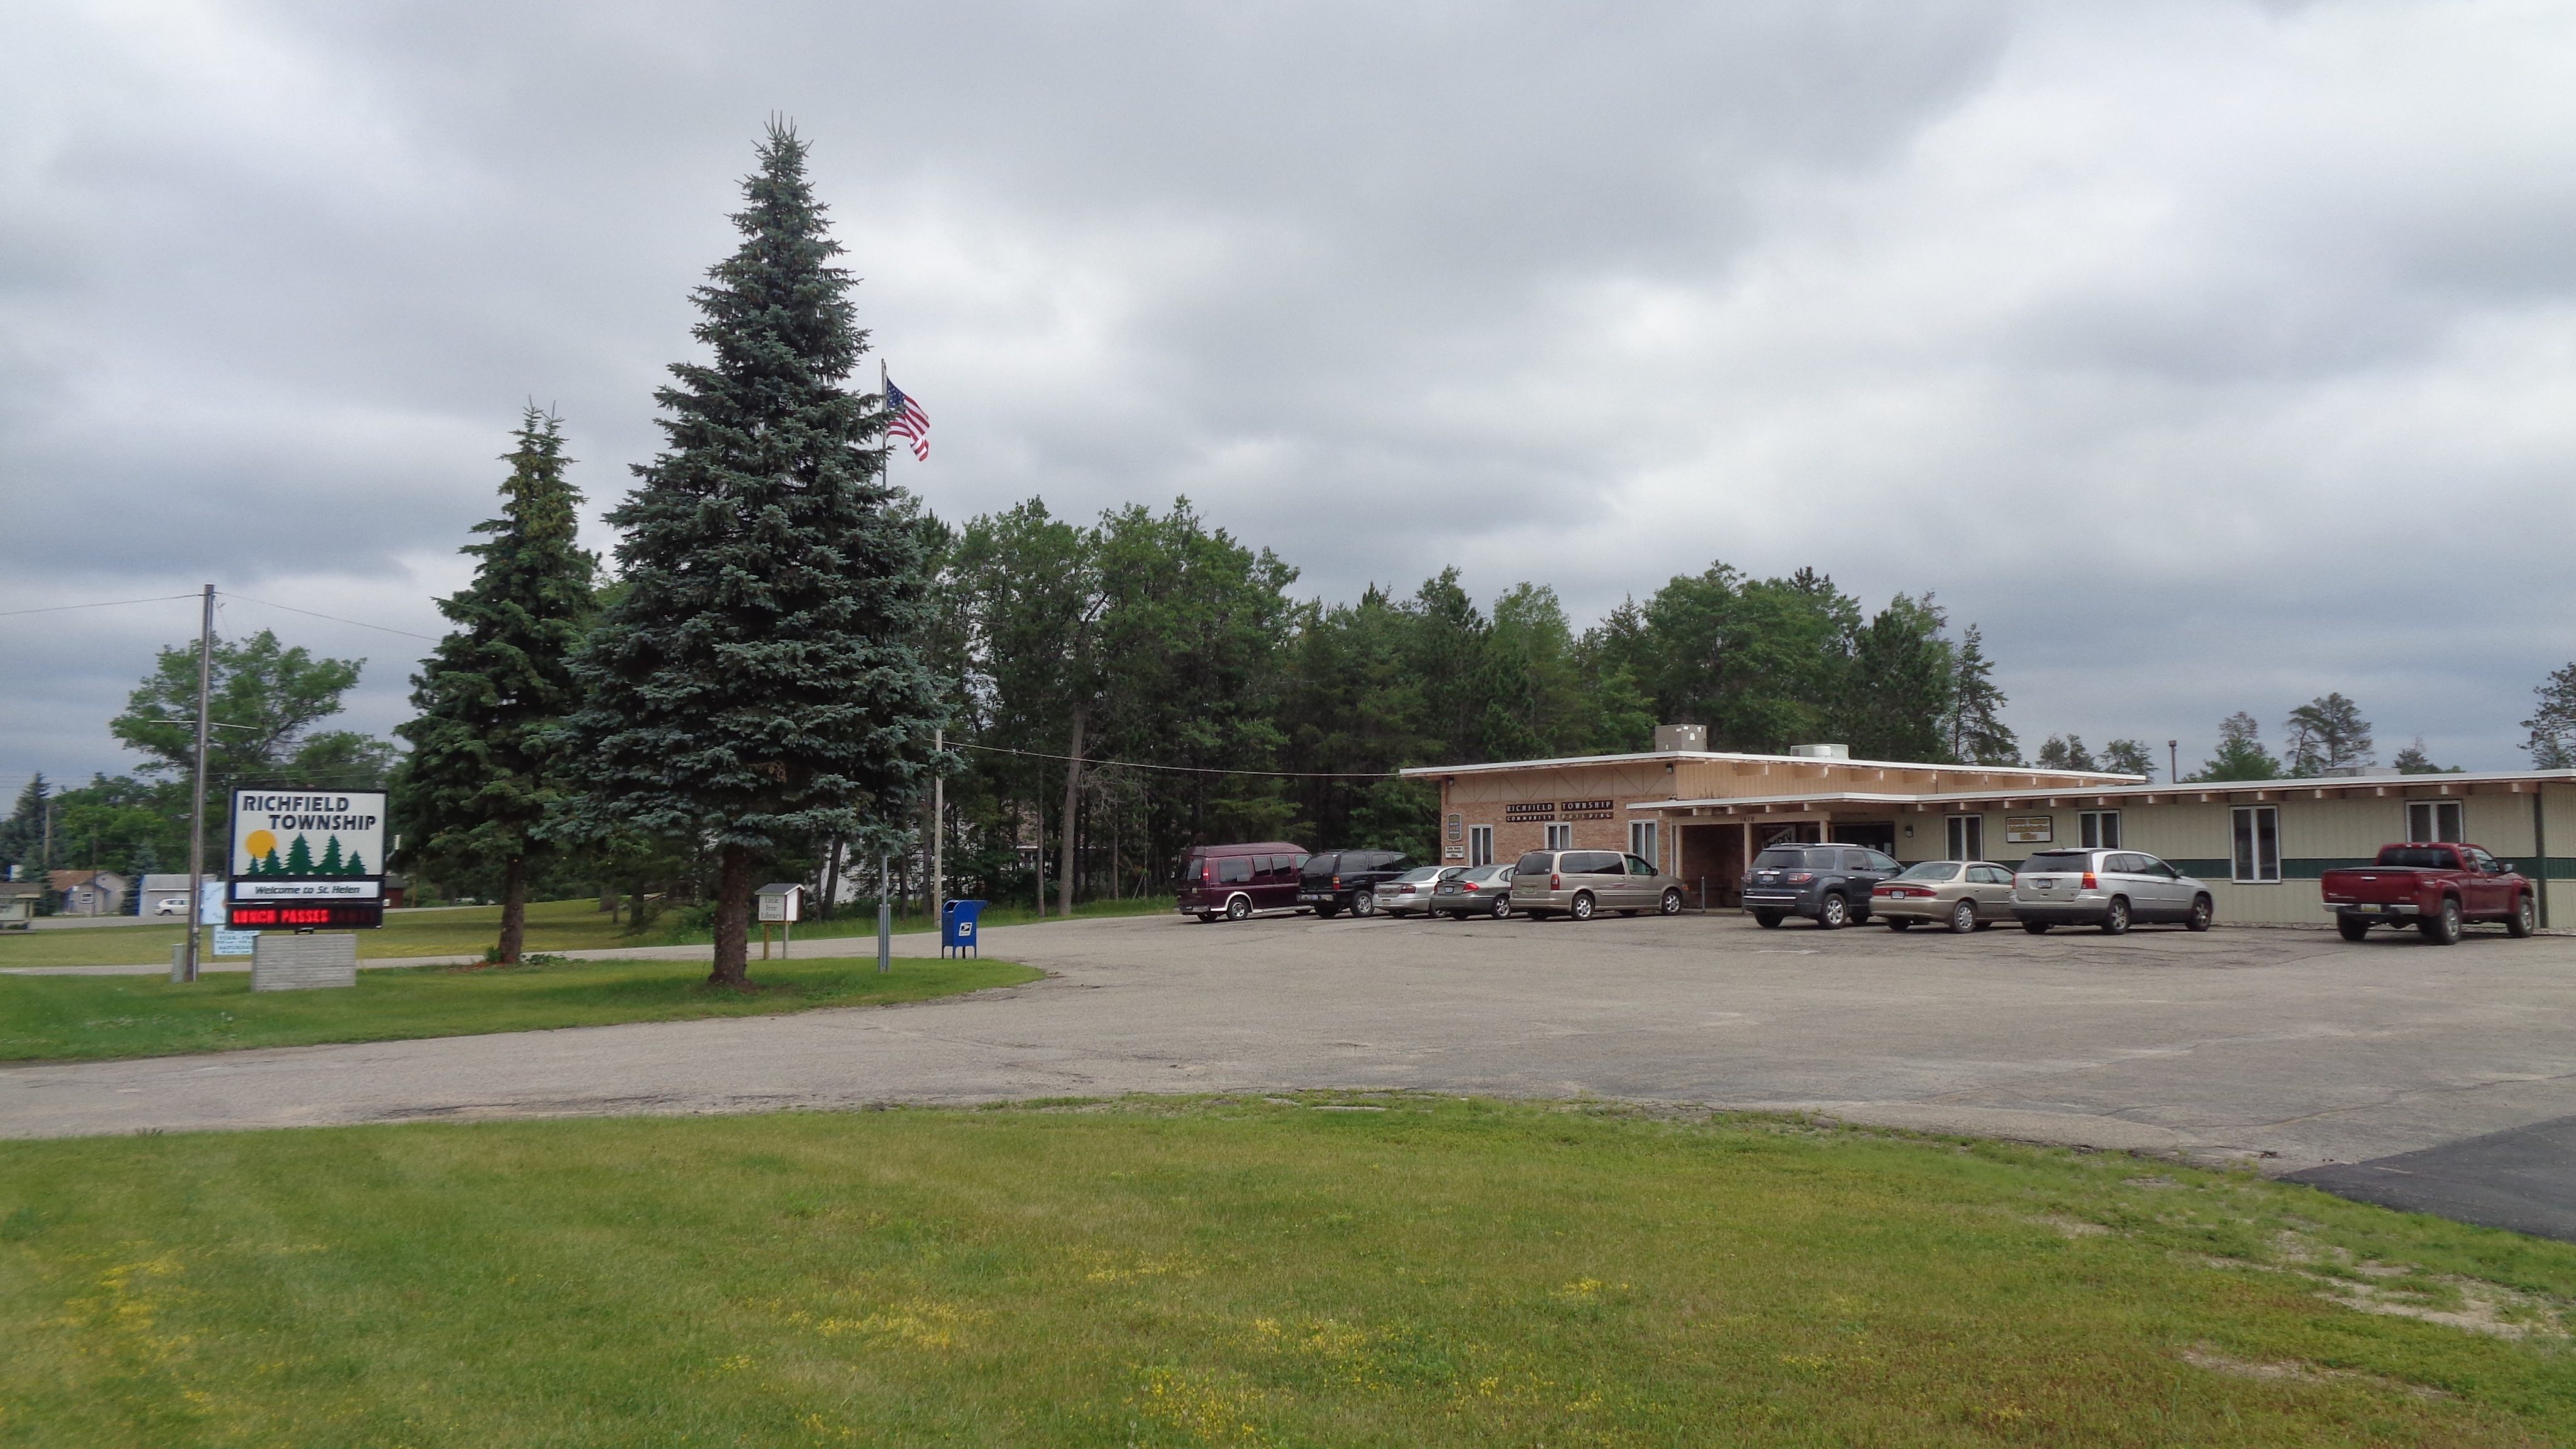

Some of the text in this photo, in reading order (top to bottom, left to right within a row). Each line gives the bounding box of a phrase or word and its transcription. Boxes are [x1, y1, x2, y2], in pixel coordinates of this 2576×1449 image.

[243, 796, 349, 812] RICHFIELD
[1507, 801, 1611, 812] RICHFIELD TOWNSHIP
[269, 814, 377, 831] TOWNSHIP
[255, 886, 300, 894] Welcome
[316, 886, 329, 894] St.
[281, 909, 330, 923] PASSES
